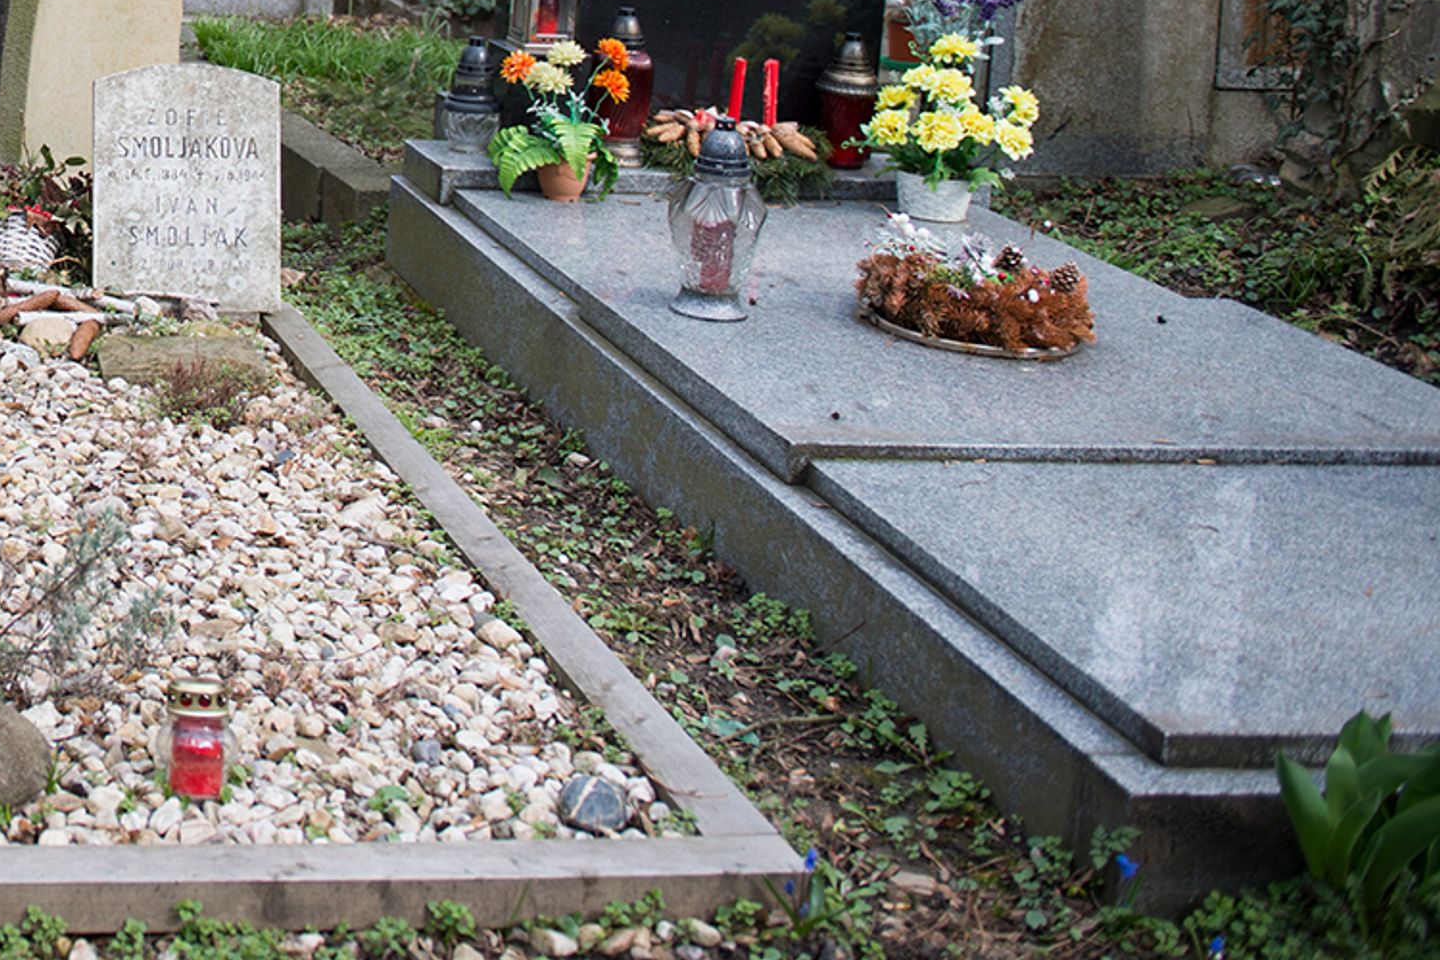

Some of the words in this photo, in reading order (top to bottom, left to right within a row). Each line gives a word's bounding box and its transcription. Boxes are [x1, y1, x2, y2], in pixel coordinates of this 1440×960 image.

[116, 136, 259, 160] SMOLJAKOVA
[155, 195, 219, 215] IVAN
[128, 224, 249, 248] SMOLJAK
